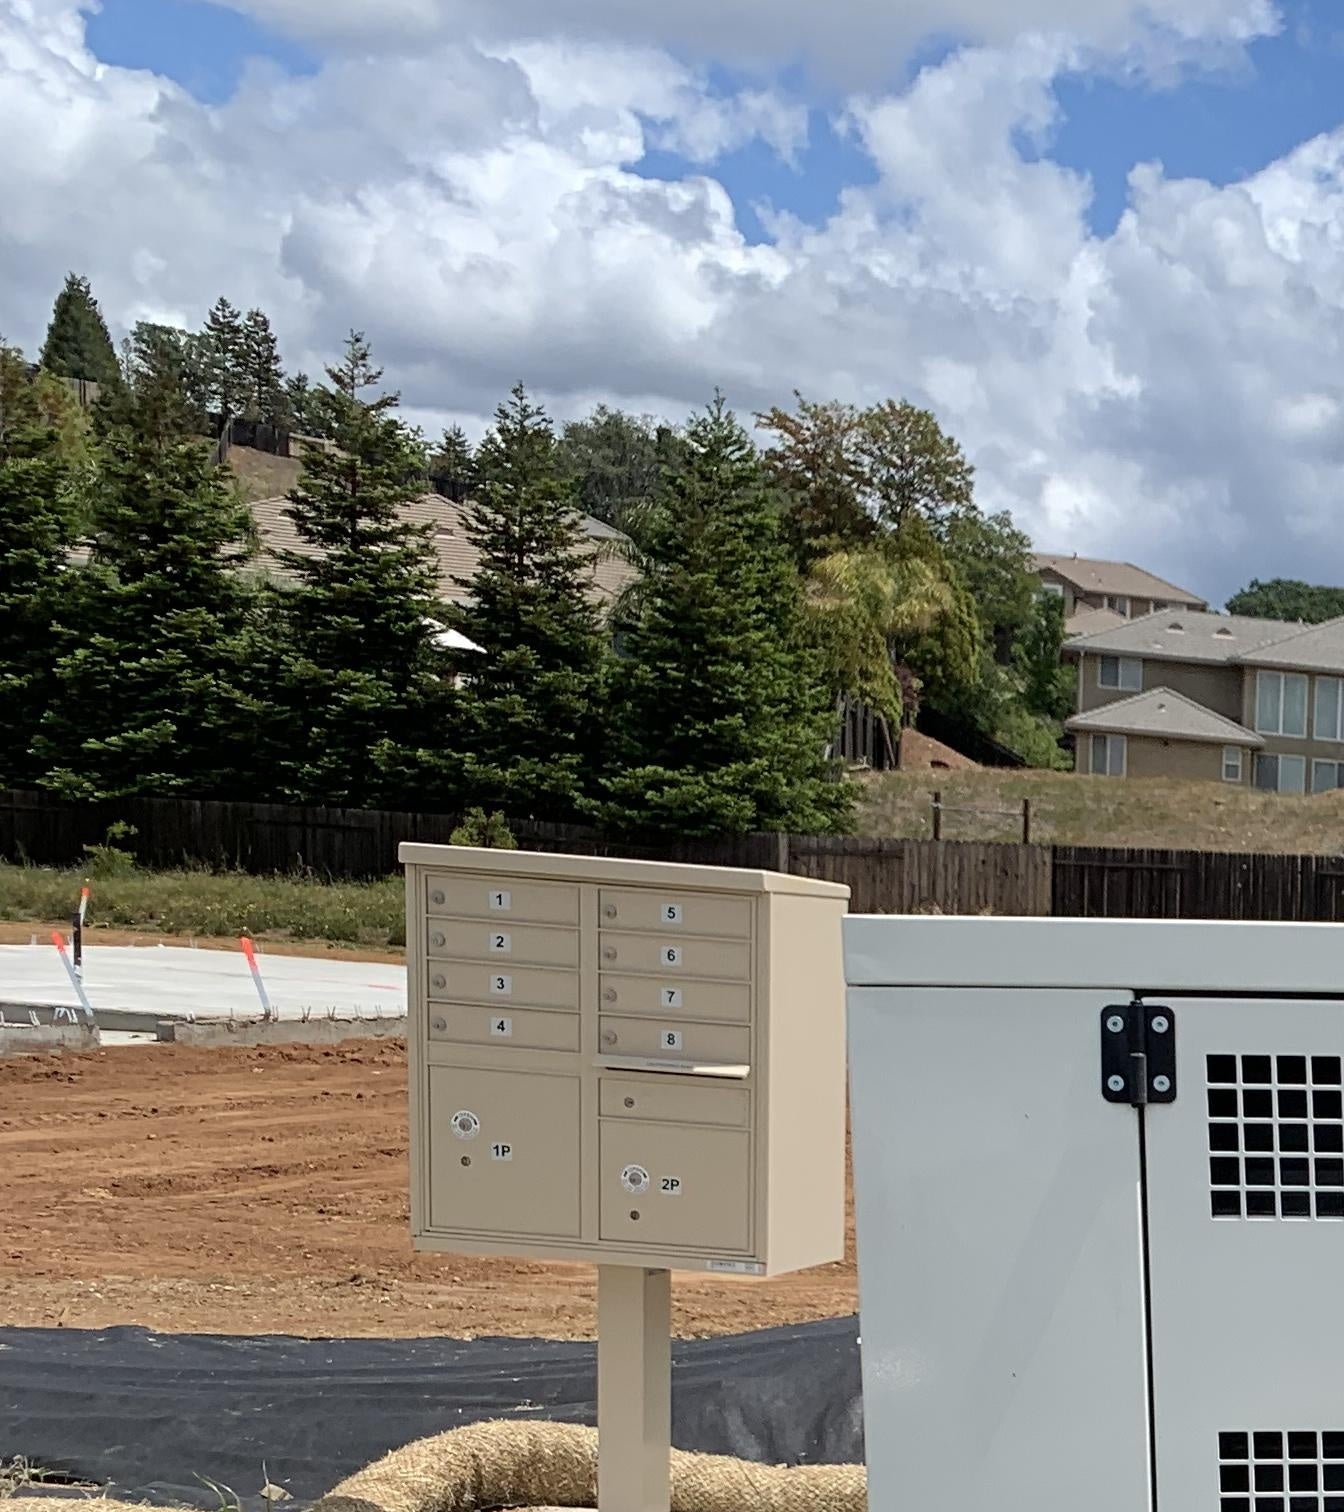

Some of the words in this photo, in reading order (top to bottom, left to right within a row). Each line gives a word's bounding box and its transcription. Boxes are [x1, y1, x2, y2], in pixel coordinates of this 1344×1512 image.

[496, 894, 503, 906] 1
[667, 907, 676, 919] 5
[495, 936, 505, 948] 2
[667, 949, 676, 962] 6
[496, 978, 505, 990] 3
[667, 991, 676, 1003] 7
[496, 1020, 506, 1032] 4
[666, 1033, 676, 1046] 8
[492, 1144, 511, 1158] 1P
[661, 1178, 680, 1191] 2P
